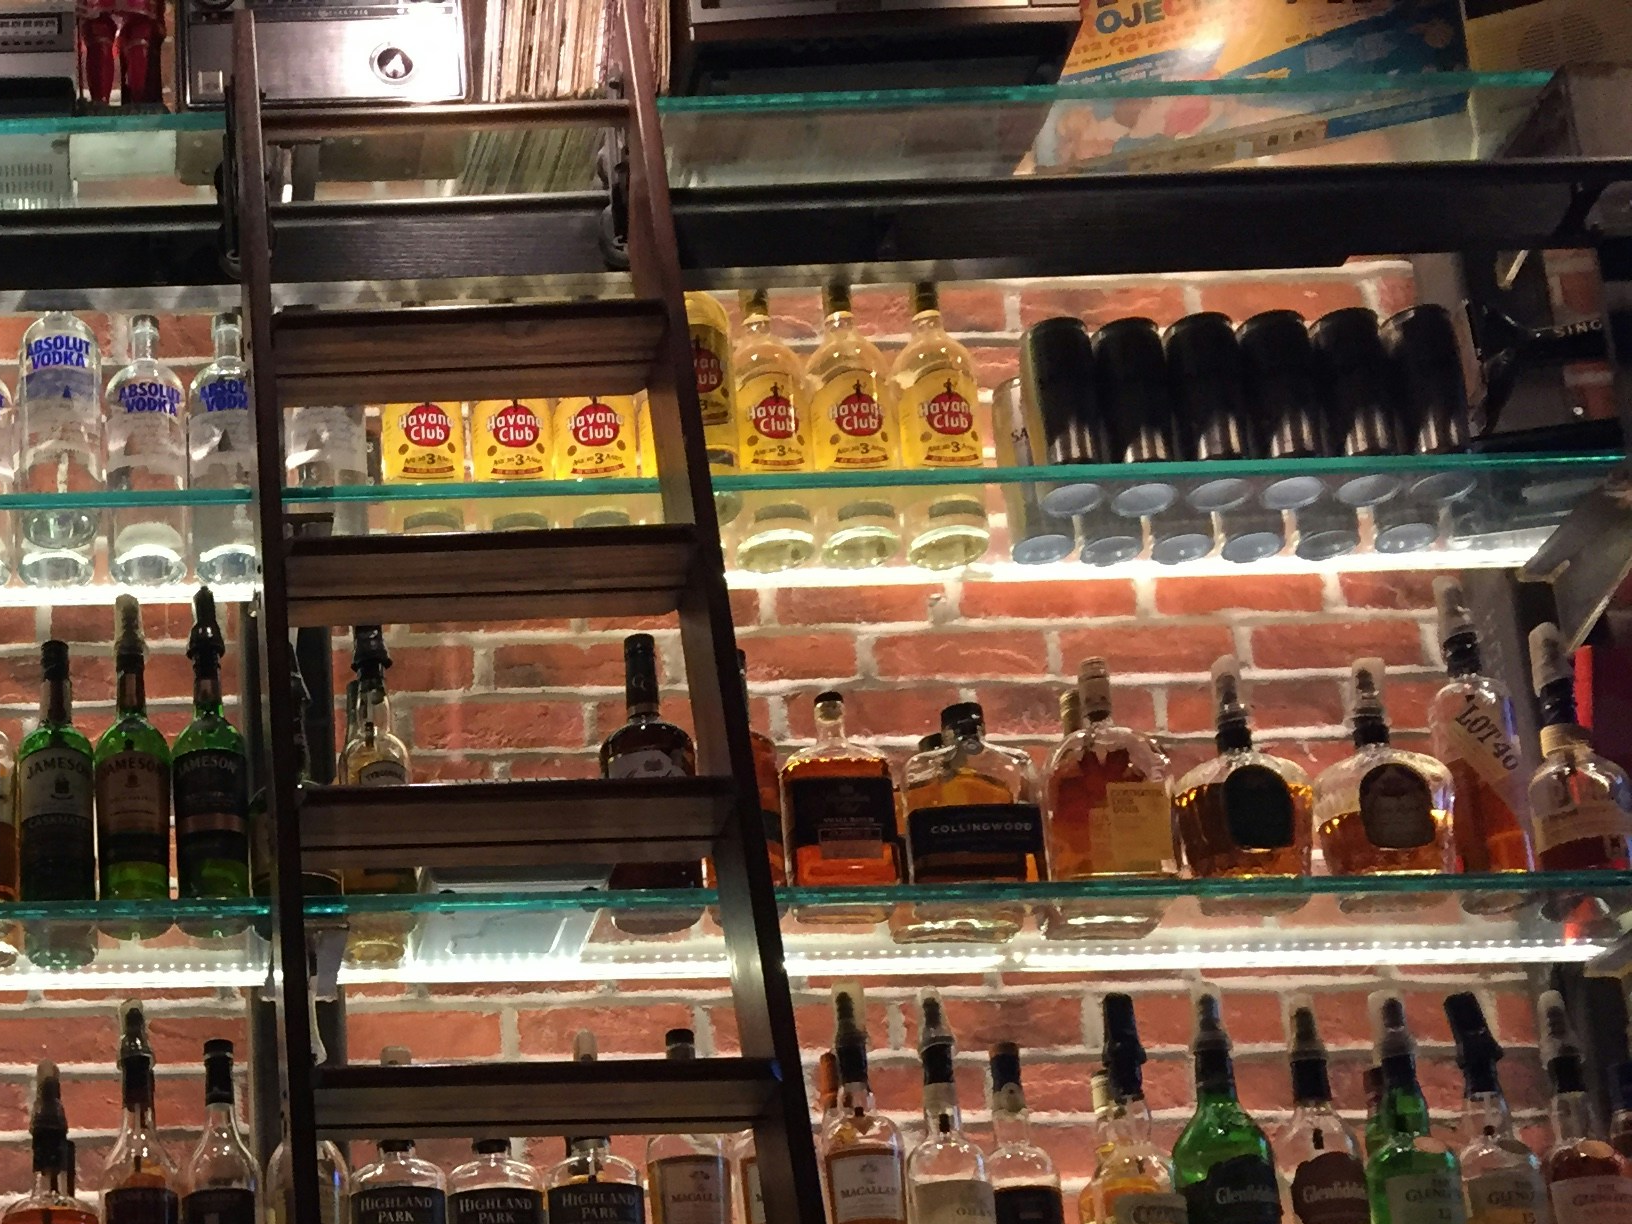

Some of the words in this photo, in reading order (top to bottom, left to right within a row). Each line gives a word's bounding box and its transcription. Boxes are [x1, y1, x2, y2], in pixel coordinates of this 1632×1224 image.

[26, 335, 91, 358] ABSOLUT
[31, 351, 87, 370] VODKA
[118, 381, 182, 404] ABSOLUT
[199, 378, 247, 400] ABSOL
[124, 396, 178, 419] VODKA
[205, 392, 249, 413] VODK
[398, 411, 455, 431] Havana
[486, 411, 544, 432] Havana
[566, 410, 624, 431] Havana
[759, 416, 796, 432] Club
[842, 415, 880, 430] Club
[933, 414, 970, 429] Club
[410, 427, 445, 441] Club
[498, 427, 535, 442] Club
[578, 426, 615, 440] Club
[776, 444, 786, 457] 3
[859, 443, 870, 455] 3
[950, 442, 961, 454] 3
[425, 453, 436, 465] 3
[514, 453, 525, 466] 3
[594, 453, 605, 465] 3
[930, 822, 1033, 834] COLLINGWOOD
[360, 1196, 433, 1212] HIGHLAND
[458, 1197, 532, 1213] HIGHLAND
[562, 1192, 636, 1208] HIGHLAND
[377, 1210, 415, 1224] PARK
[478, 1211, 516, 1224] PARK
[581, 1206, 619, 1220] PARK
